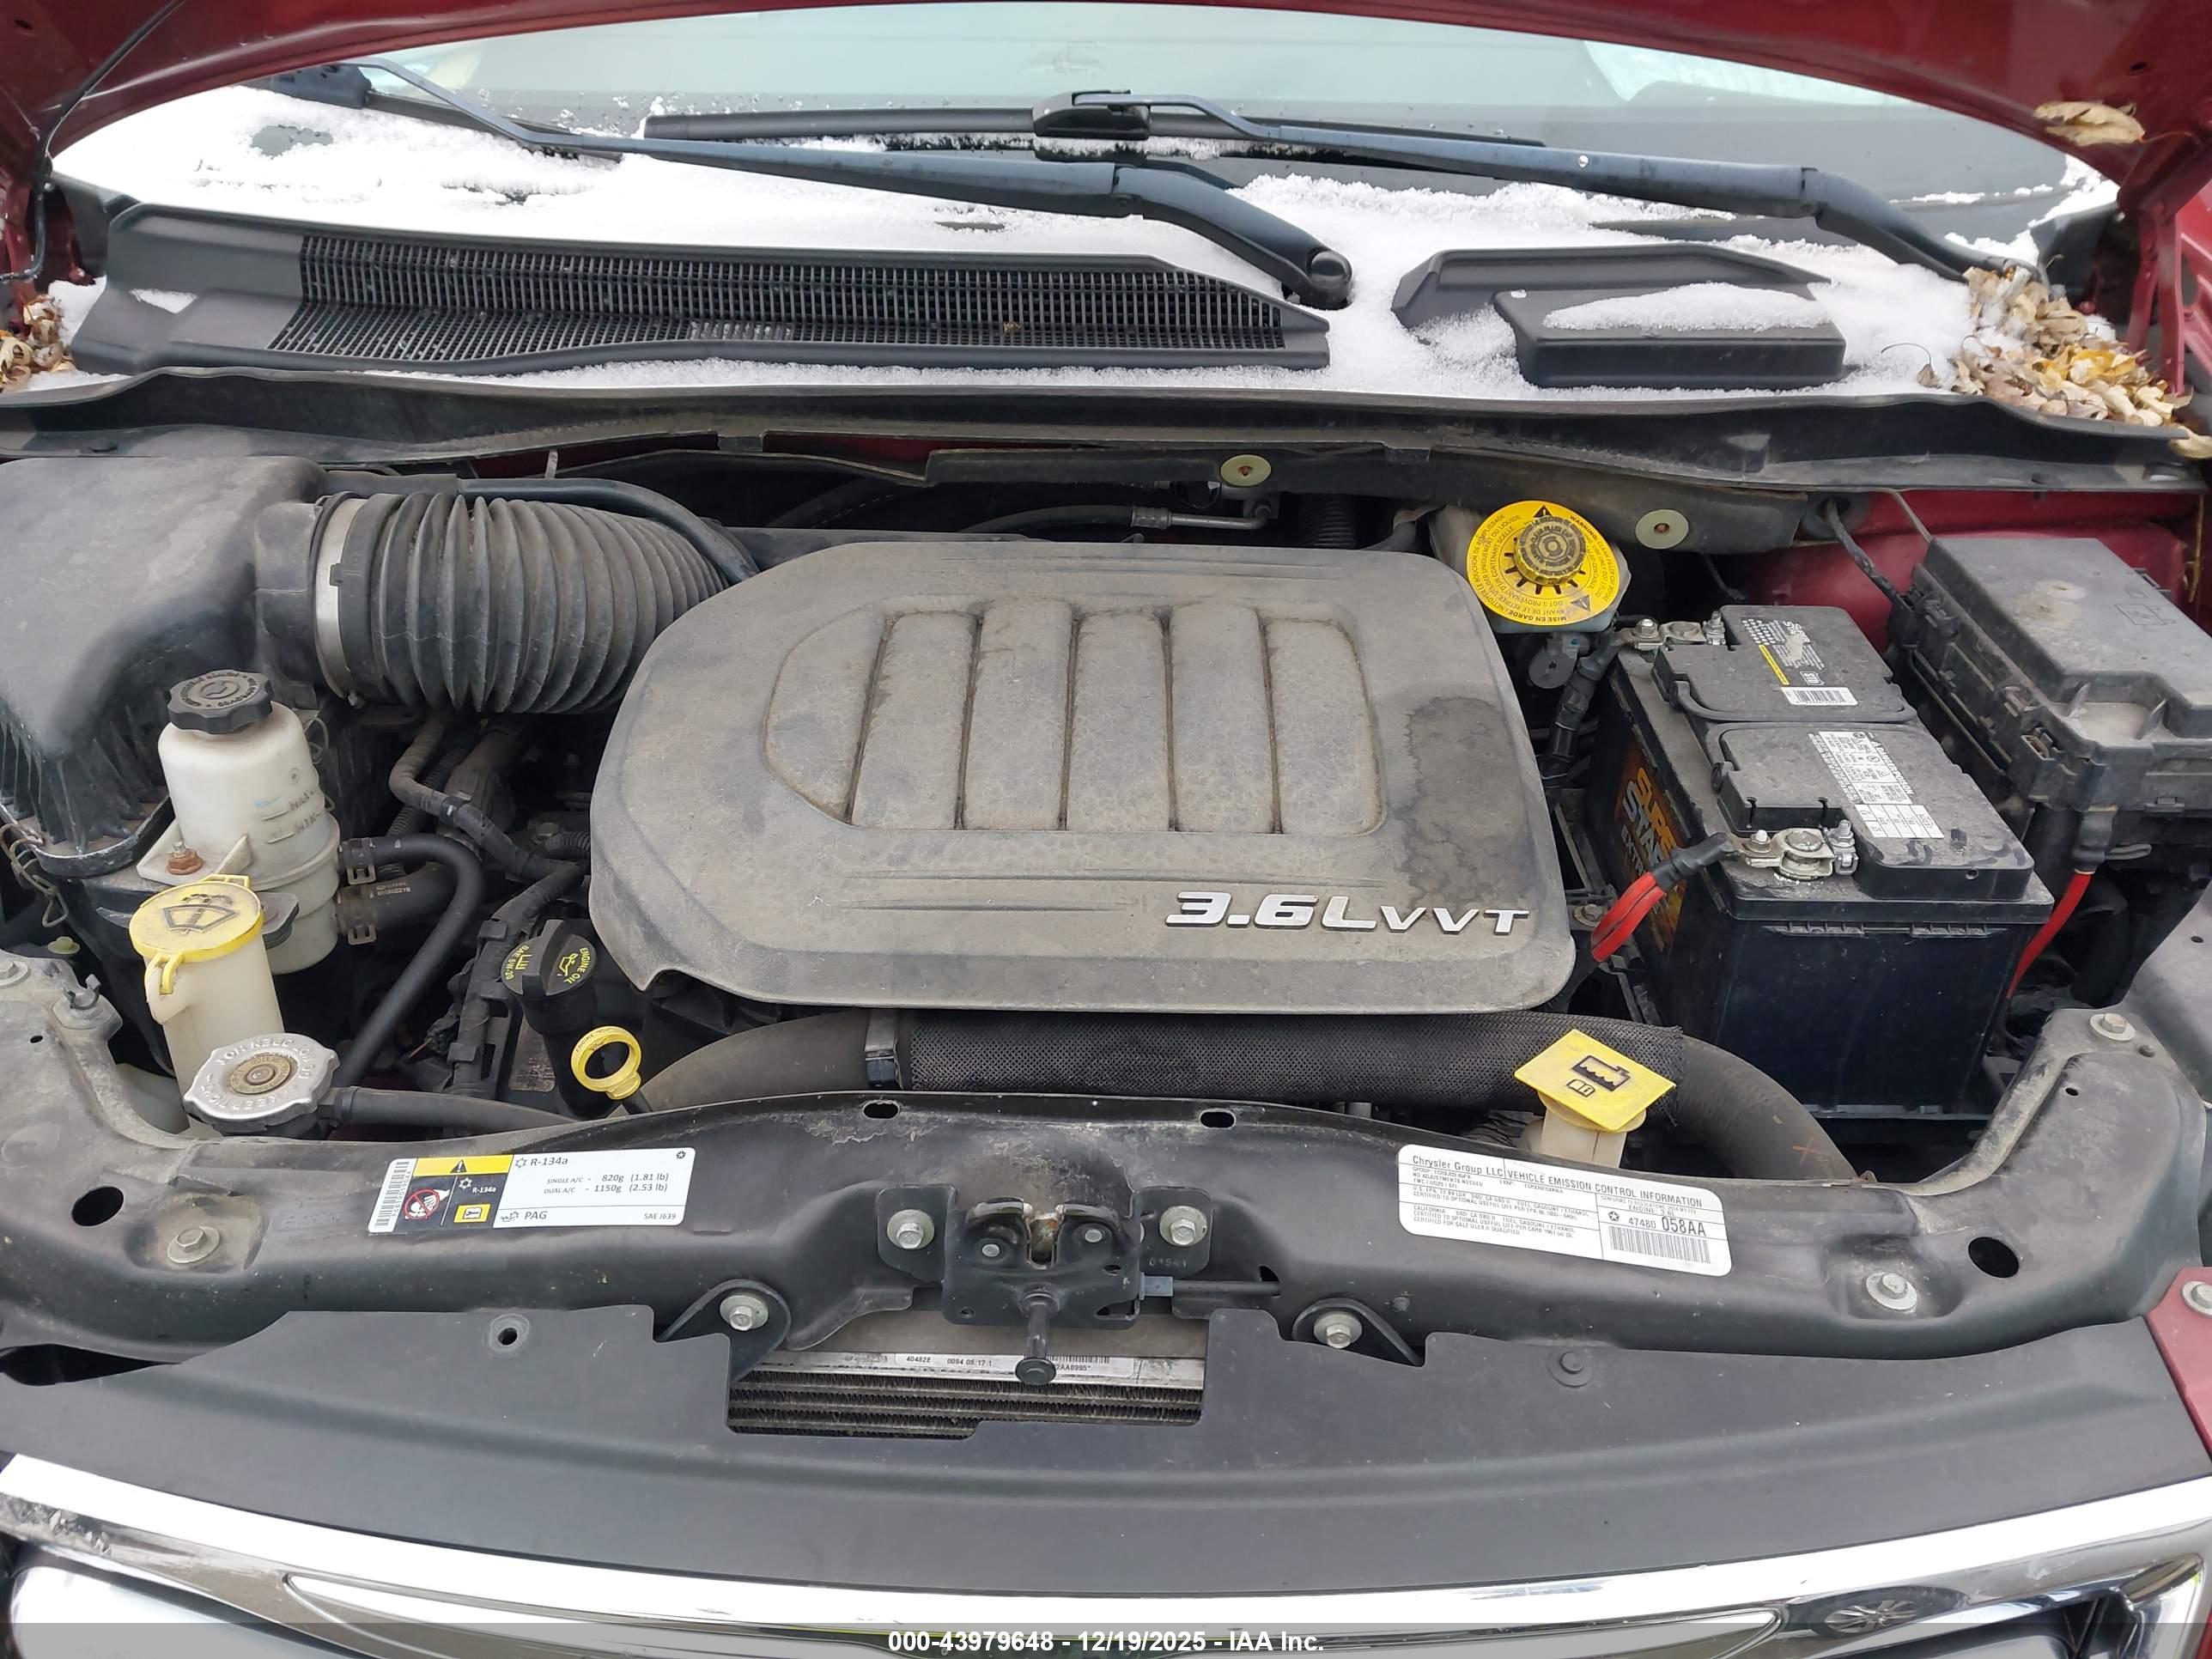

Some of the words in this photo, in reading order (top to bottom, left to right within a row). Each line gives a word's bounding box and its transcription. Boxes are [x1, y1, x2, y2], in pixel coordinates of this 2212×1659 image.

[1509, 610, 1534, 621] GARDE
[1164, 891, 1377, 933] 3.6L
[1380, 904, 1530, 935] VVT
[576, 947, 591, 973] ENGINE
[563, 973, 581, 985] OIL
[530, 1157, 568, 1167] R-134a
[601, 1174, 624, 1183] 820g
[630, 1173, 653, 1183] (1.81
[656, 1172, 670, 1182] lb)
[1413, 1155, 1450, 1170] Chrysler
[1454, 1162, 1483, 1176] Group
[1486, 1167, 1504, 1177] LLC
[1507, 1170, 1546, 1183] VEHICLE
[1548, 1176, 1592, 1191] EMISSION
[1595, 1183, 1638, 1198] CONTROL
[1640, 1190, 1703, 1207] INFORMATION
[471, 1186, 497, 1194] R-134a
[593, 1184, 622, 1194] 1150g
[629, 1183, 653, 1194] (2.53
[655, 1182, 668, 1193] lb)
[1413, 1191, 1442, 1200] CERTIFIED
[1451, 1196, 1478, 1206] OPTIONAL
[524, 1211, 548, 1220] PAG
[1413, 1211, 1442, 1219] CERTIFIED
[1451, 1215, 1479, 1224] OPTIONAL
[1628, 1217, 1657, 1230] 47480
[1662, 1216, 1707, 1237] 058AA
